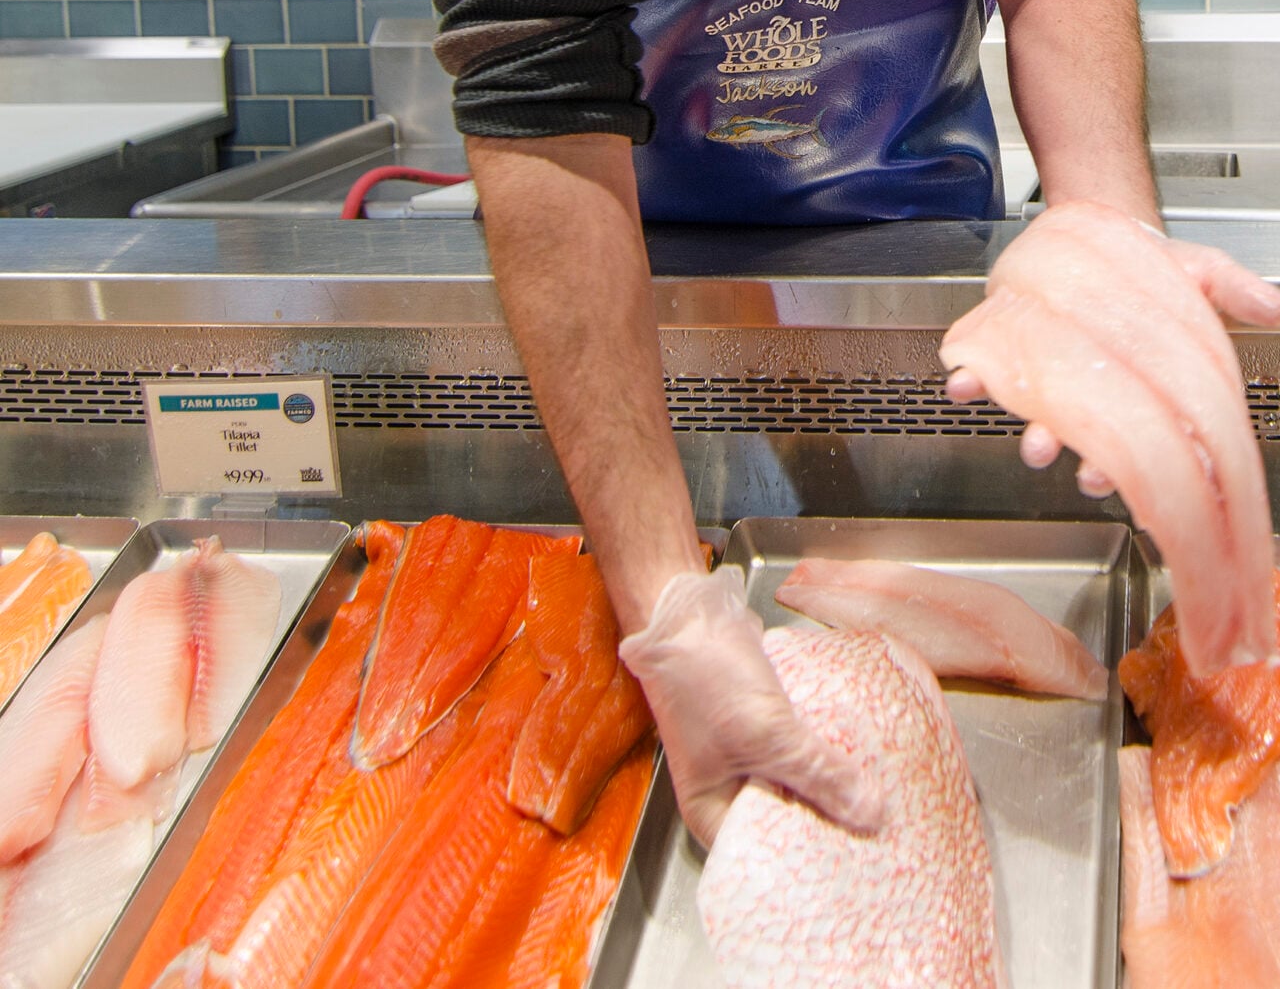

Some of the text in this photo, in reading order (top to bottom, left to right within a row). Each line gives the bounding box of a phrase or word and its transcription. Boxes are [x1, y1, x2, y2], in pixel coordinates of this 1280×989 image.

[721, 15, 828, 52] WHOLE
[723, 40, 822, 64] FOODS
[725, 56, 816, 72] MARKET
[716, 75, 818, 104] Jackson
[180, 397, 258, 409] FARM RAISED
[221, 430, 261, 441] Tilapia
[228, 442, 258, 452] Fillet
[224, 468, 264, 484] $9.99
